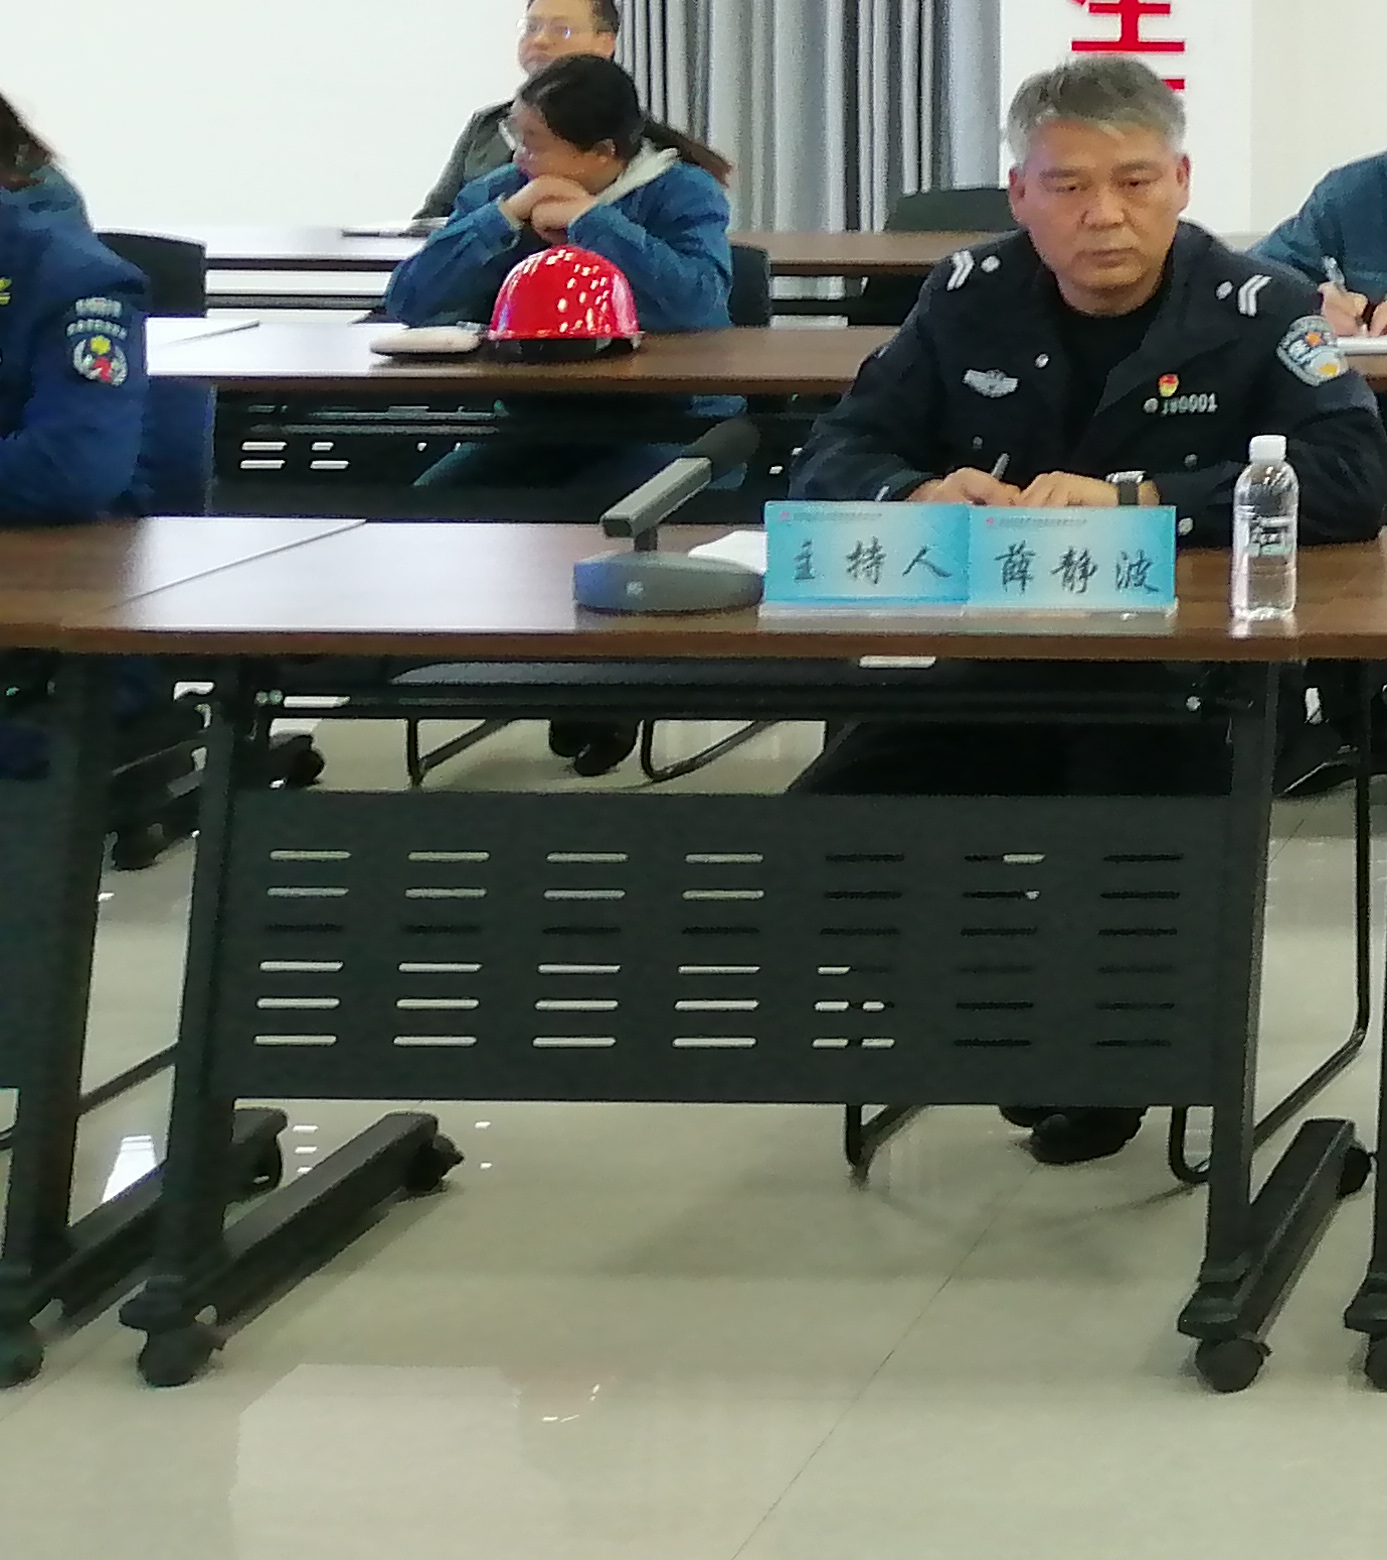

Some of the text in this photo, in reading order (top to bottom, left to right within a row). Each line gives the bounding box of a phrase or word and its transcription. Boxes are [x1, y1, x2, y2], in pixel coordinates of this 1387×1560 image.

[794, 536, 952, 585] 主持人
[994, 540, 1159, 594] 薛静波
